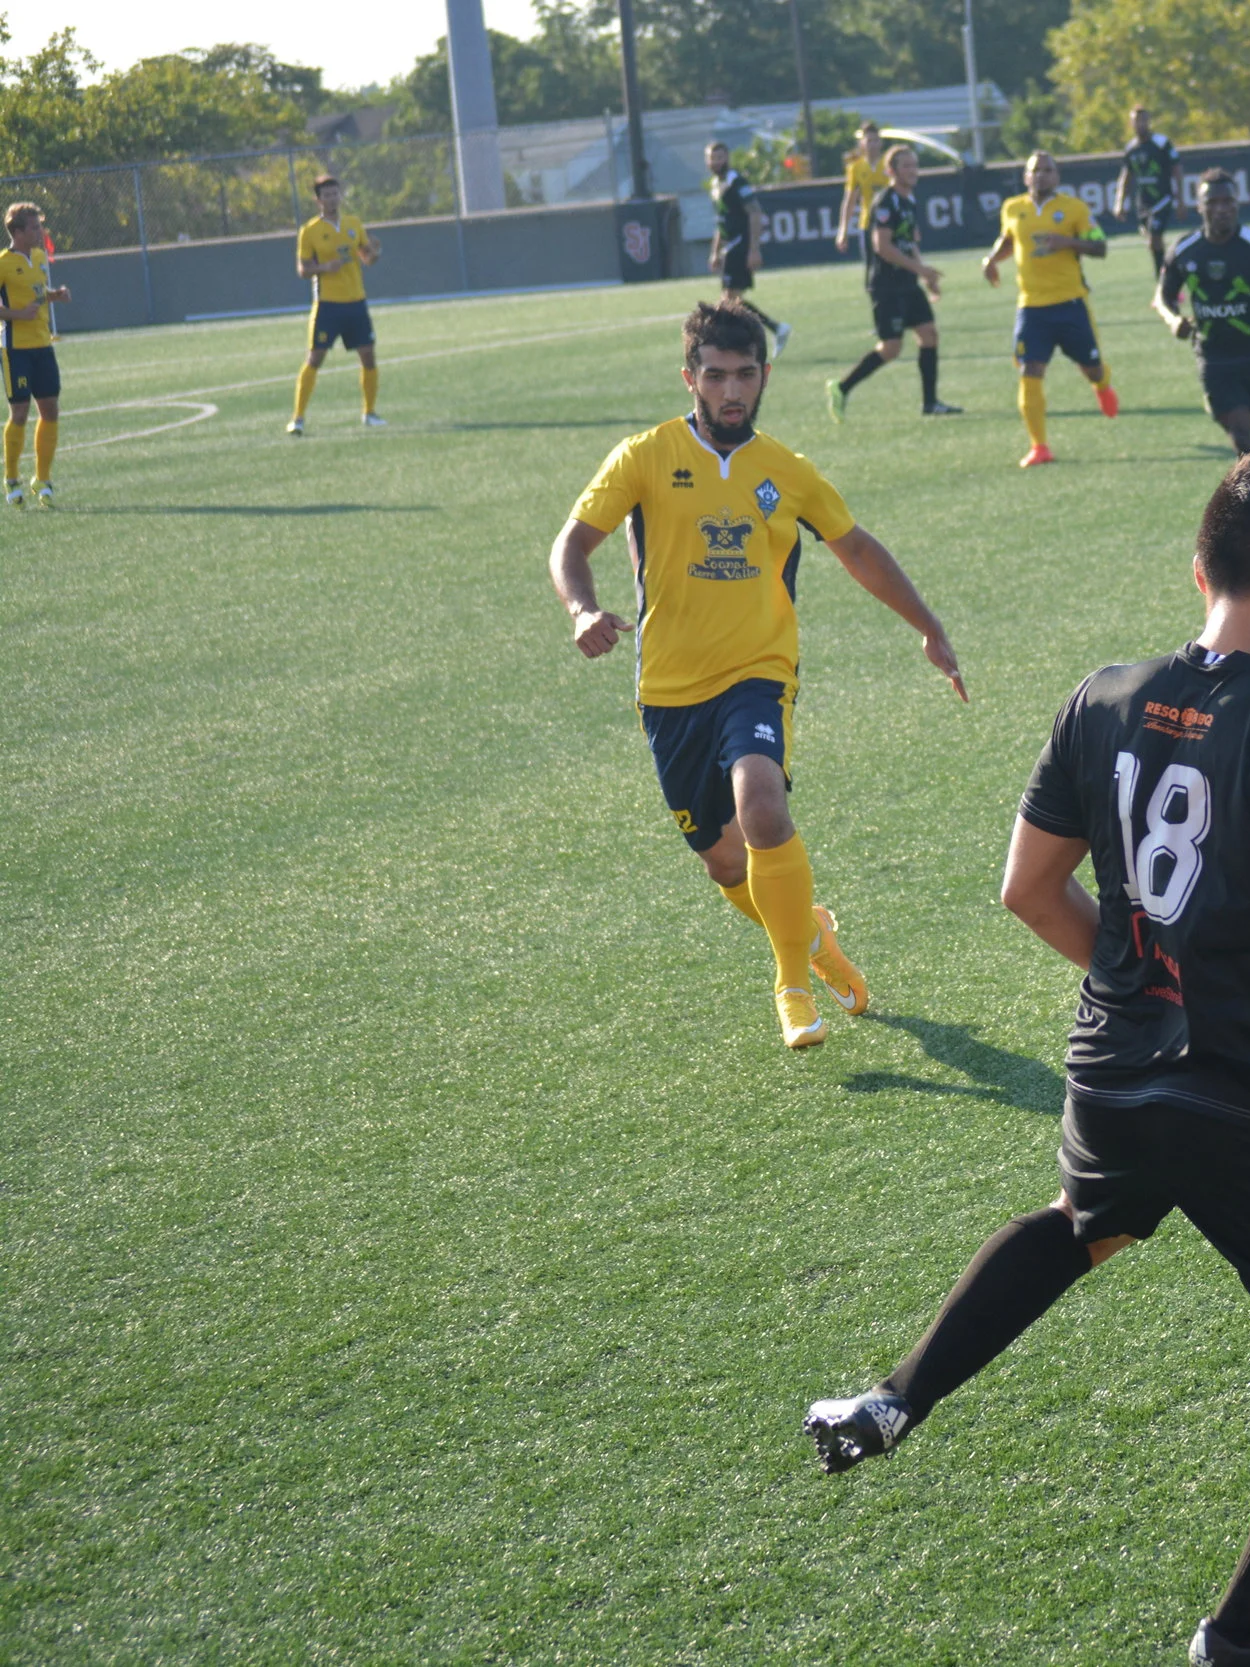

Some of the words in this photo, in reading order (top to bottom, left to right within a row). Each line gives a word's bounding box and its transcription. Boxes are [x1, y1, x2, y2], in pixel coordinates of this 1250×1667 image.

[1144, 701, 1180, 722] RESQ
[1114, 751, 1212, 926] 18
[865, 1402, 894, 1449] adidas
